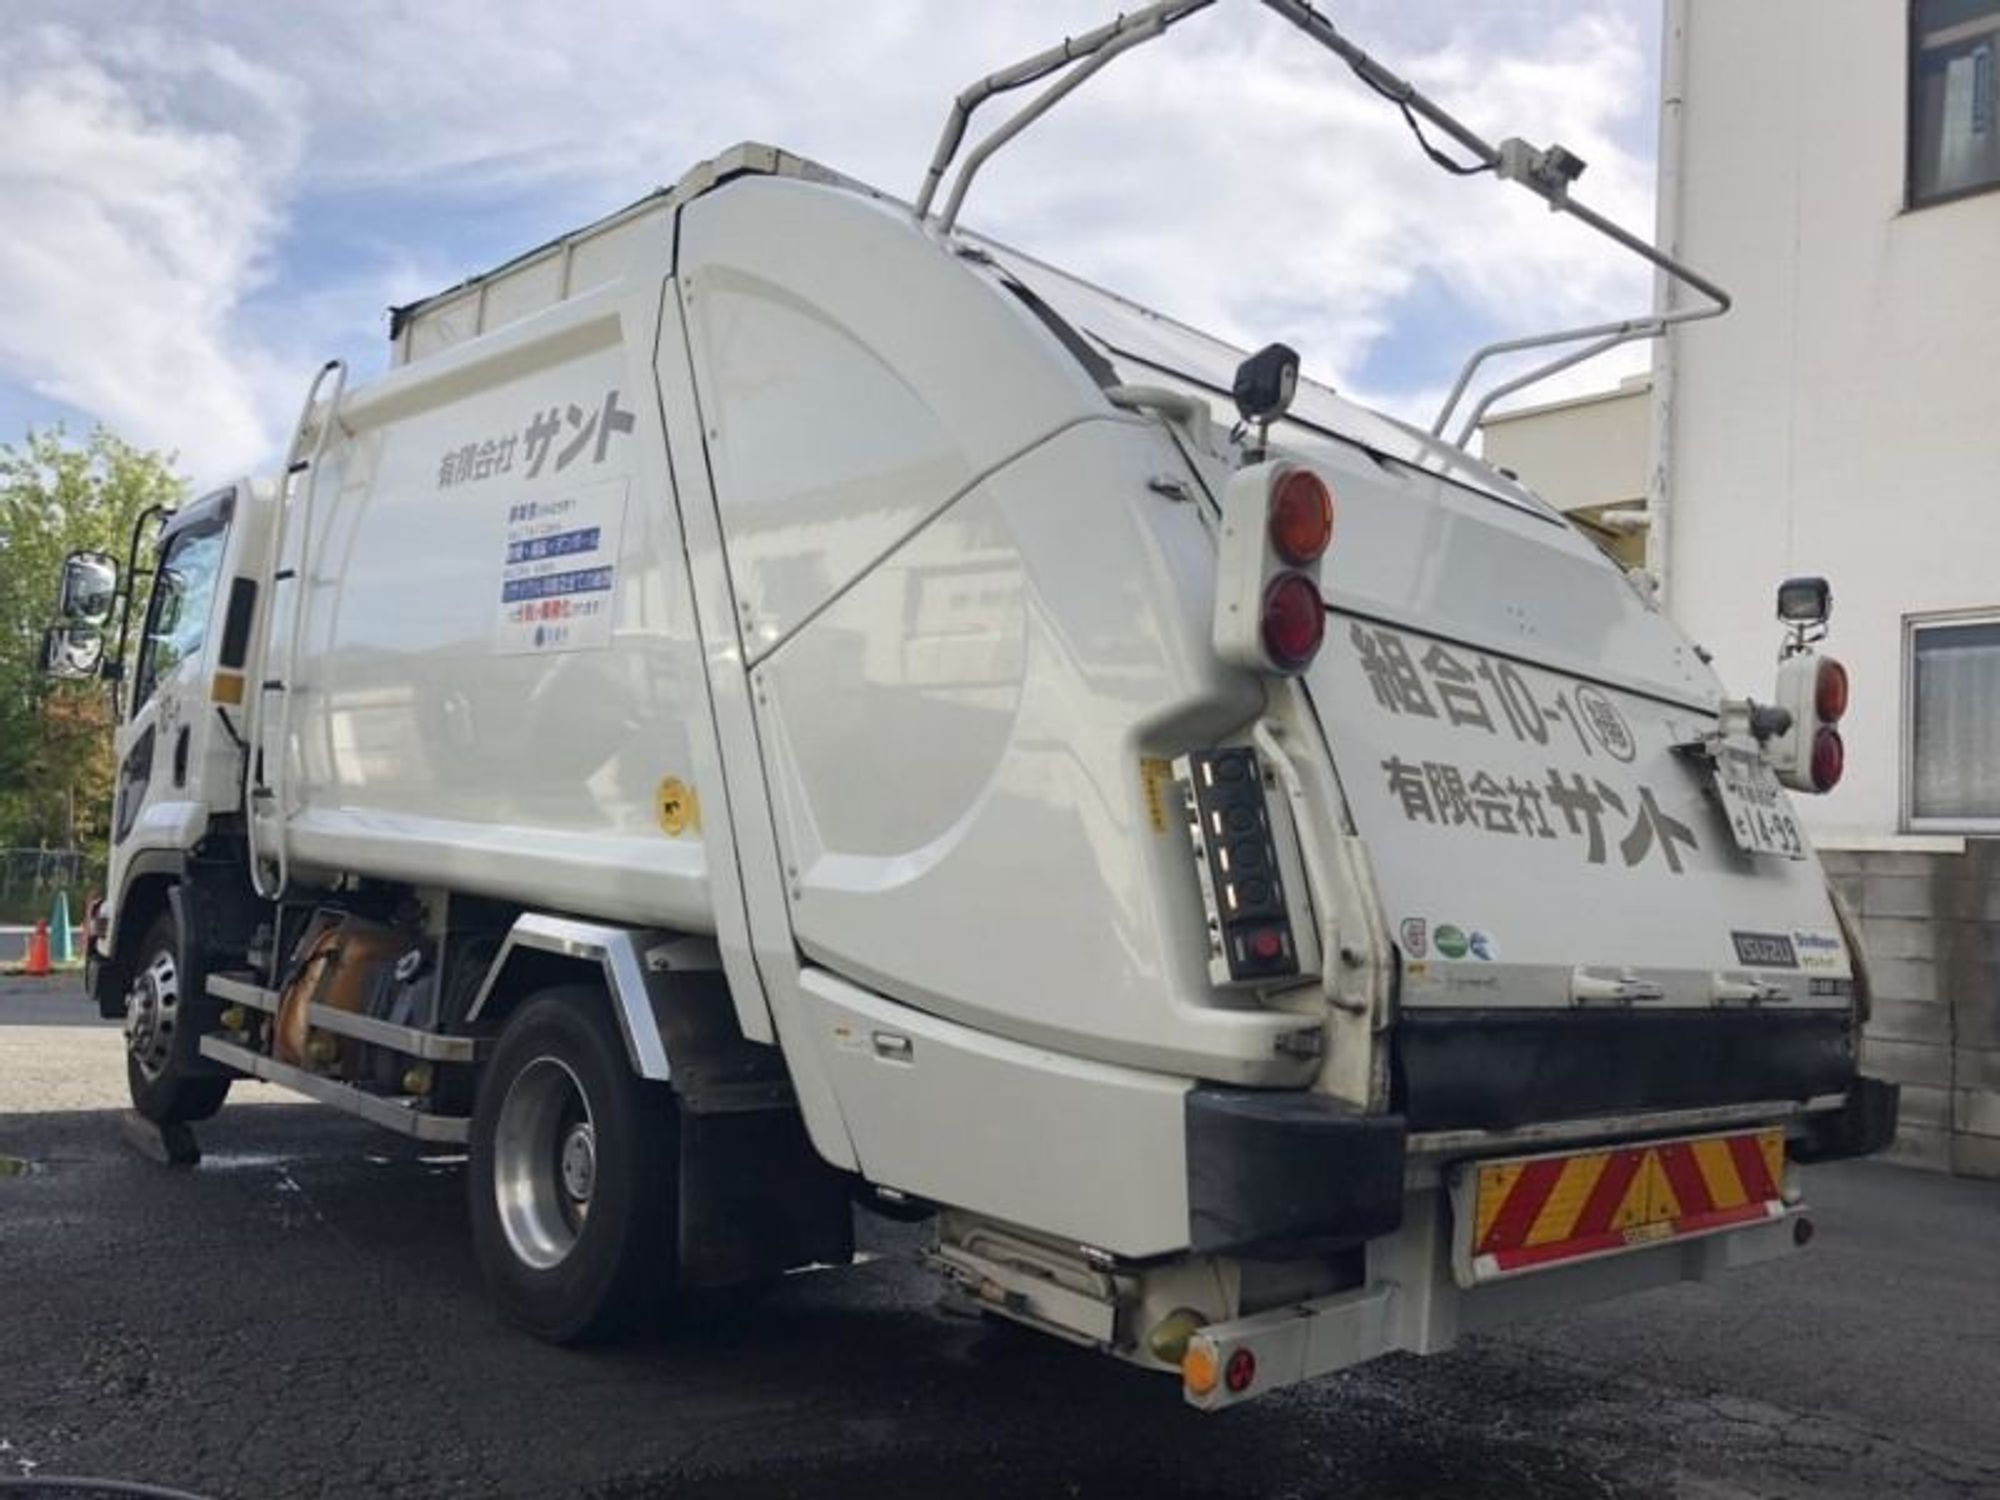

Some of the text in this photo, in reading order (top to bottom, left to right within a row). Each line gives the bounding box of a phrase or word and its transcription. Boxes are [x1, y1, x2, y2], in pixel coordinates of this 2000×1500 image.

[1382, 757, 1698, 874] 有限会社サント
